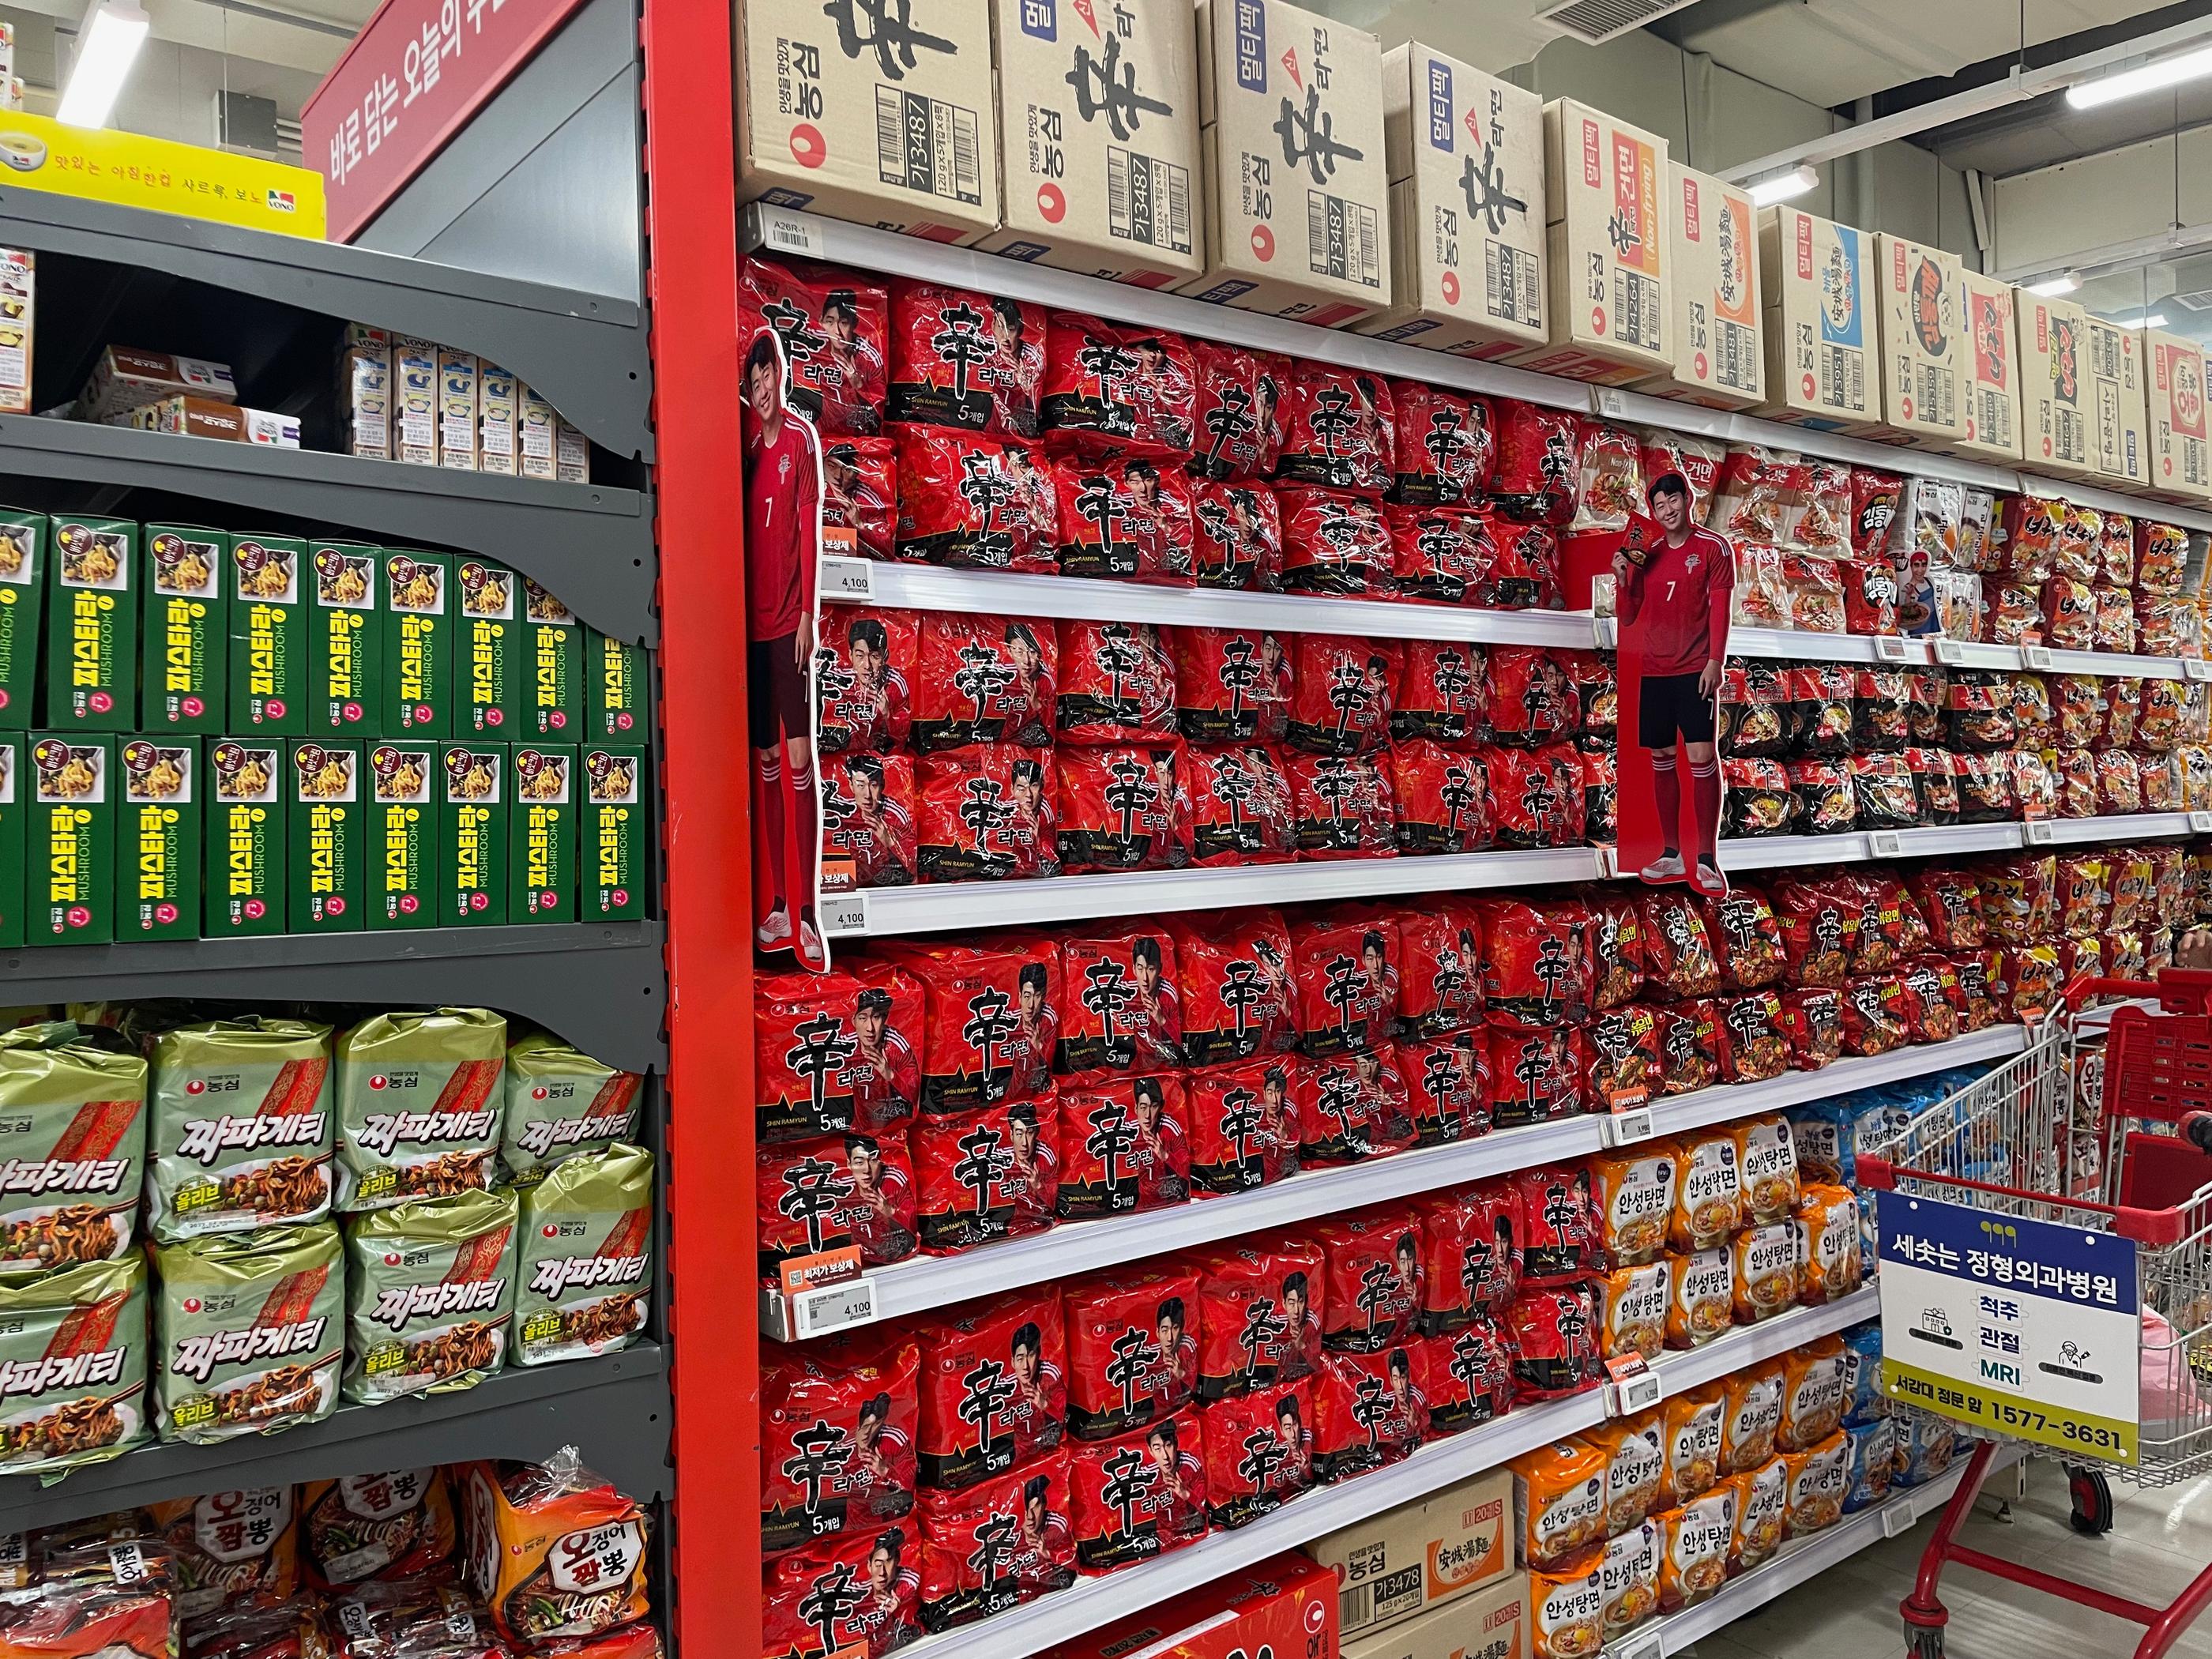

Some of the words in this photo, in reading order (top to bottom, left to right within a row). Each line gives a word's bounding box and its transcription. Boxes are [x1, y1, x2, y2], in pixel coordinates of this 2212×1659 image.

[777, 37, 790, 76] 맛있게
[1240, 2, 1264, 81] 멀티팩
[1312, 27, 1333, 92] 라면
[330, 107, 363, 186] 바로
[364, 73, 399, 156] 담는
[403, 0, 461, 108] 오늘의
[777, 79, 791, 115] 인생을
[792, 42, 823, 119] 농심
[1065, 31, 1173, 141] 辛
[1027, 103, 1038, 138] 맛있게
[1431, 68, 1450, 141] 멀티팩
[1490, 88, 1504, 149] 라면
[908, 98, 926, 185] 가3487
[1039, 107, 1064, 179] 농심
[1273, 84, 1364, 185] 辛
[1585, 125, 1598, 181] 멀티팩
[1029, 141, 1039, 174] 인생을
[1618, 145, 1635, 204] 건면
[55, 156, 100, 175] 맛있는
[235, 188, 263, 205] 보노
[1132, 157, 1148, 237] 가3487
[1251, 154, 1272, 220] 농심
[1458, 141, 1528, 235] 辛
[269, 201, 295, 212] VONO
[1642, 157, 1657, 261] (Non-frying)
[1686, 183, 1697, 235] 멀티팩
[773, 220, 807, 235] A26R-1
[1329, 201, 1344, 273] 가3487
[1443, 208, 1458, 268] 농심
[1607, 206, 1641, 256] 辛
[1718, 205, 1736, 303] 安城湯麵
[1799, 220, 1811, 273] 멀티팩
[1502, 248, 1512, 315] 가3487
[1593, 252, 1604, 302] 농심
[1830, 246, 1845, 322] 安城湯麵
[1896, 246, 1905, 288] 멀티팩
[1629, 278, 1638, 344] 가4264
[1695, 303, 1705, 349] 농심
[356, 339, 384, 349] VONO
[931, 301, 996, 401] 辛
[1729, 328, 1737, 384] 가3481
[1802, 323, 1813, 371] 농심
[1834, 353, 1844, 404] 가3951
[1902, 355, 1911, 395] 농심
[957, 406, 984, 423] 5개입
[1687, 460, 1714, 484] 건면
[765, 496, 773, 528] 7
[825, 539, 849, 551] 보상제
[841, 577, 868, 589] 4,100
[1666, 580, 1676, 602] 7
[73, 589, 115, 688] 파스타랑
[100, 612, 114, 687] MUSHROOM
[51, 805, 92, 902] 파스타랑
[386, 805, 419, 891] 파스타랑
[408, 823, 419, 890] MUSHROOM
[600, 806, 629, 886] 파스타랑
[619, 822, 628, 885] MUSHROOM
[997, 830, 1033, 846] 라면
[78, 826, 91, 901] MUSHROOM
[824, 873, 849, 884] 보상제
[952, 860, 975, 869] RAMYUN
[837, 913, 864, 924] 4,100
[1082, 955, 1137, 1047] 辛
[962, 985, 1020, 1082] 辛
[1119, 1012, 1150, 1028] 라면
[1631, 1013, 1654, 1036] 볶음면
[786, 1010, 858, 1112] 辛
[999, 1040, 1029, 1060] 라면
[208, 1079, 239, 1093] 농심
[389, 1077, 419, 1089] 농심
[549, 1087, 574, 1098] 농심
[837, 1065, 874, 1089] 라면
[179, 1112, 325, 1164] 짜파게티
[359, 1109, 495, 1157] 짜파게티
[518, 1110, 635, 1158] 짜파게티
[820, 1113, 846, 1131] 5개입
[1085, 1099, 1139, 1191] 辛
[1126, 1149, 1153, 1169] 라면
[1746, 1145, 1793, 1178] 안성탕면
[175, 1184, 220, 1211] 올리브
[358, 1174, 397, 1198] 올리브
[1627, 1175, 1638, 1183] 농심
[1688, 1168, 1737, 1198] 안성탕면
[778, 1156, 853, 1254] 辛
[830, 1206, 874, 1228] 라면
[1112, 1193, 1134, 1209] 5개입
[1619, 1185, 1667, 1216] 안성탕면
[559, 1226, 586, 1236] 농심
[403, 1253, 429, 1266] 농심
[803, 1264, 829, 1279] 최저가
[830, 1258, 855, 1273] 보상제
[1751, 1240, 1794, 1271] 안성탕면
[1892, 1233, 1962, 1271] 세솟는
[1966, 1247, 2118, 1305] 정형외과병원
[529, 1254, 649, 1300] 짜파게티
[1686, 1266, 1729, 1298] 안성탕면
[204, 1300, 236, 1312] 농심
[371, 1278, 506, 1328] 짜파게티
[845, 1301, 871, 1316] 4,100
[1980, 1296, 2019, 1321] 척추
[523, 1319, 561, 1340] 올리브
[1980, 1326, 2020, 1354] 관절
[171, 1317, 326, 1382] 짜파게티
[365, 1349, 404, 1374] 올리브
[0, 1346, 126, 1395] 파게티
[1981, 1359, 2020, 1386] MRI
[173, 1402, 215, 1427] 올리브
[958, 1358, 1018, 1454] 辛
[999, 1401, 1033, 1426] 라면
[1895, 1374, 1934, 1401] 서강대
[1938, 1386, 1965, 1408] 정문
[1968, 1396, 1982, 1414] 앞
[1991, 1401, 2120, 1450] 1577-3631
[782, 1420, 854, 1514] 辛
[833, 1469, 874, 1492] 라면
[987, 1454, 1010, 1471] 5개입
[208, 1488, 281, 1525] 오징어
[361, 1477, 419, 1510] 짬뽕
[812, 1516, 840, 1536] 5개입
[1541, 1498, 1601, 1533] 안성탕면
[216, 1518, 274, 1552] 짬뽕
[561, 1523, 626, 1571] 오징어
[1349, 1547, 1367, 1560] 인생을
[1367, 1541, 1385, 1553] 맛있게
[1682, 1524, 1732, 1556] 안성탕면
[571, 1550, 625, 1587] 짬뽕
[1349, 1552, 1385, 1581] 농심
[1439, 1537, 1490, 1571] 安城湯麵
[1376, 1569, 1420, 1599] 가3478
[1382, 1601, 1393, 1610] 125
[1544, 1589, 1602, 1622] 안성탕면
